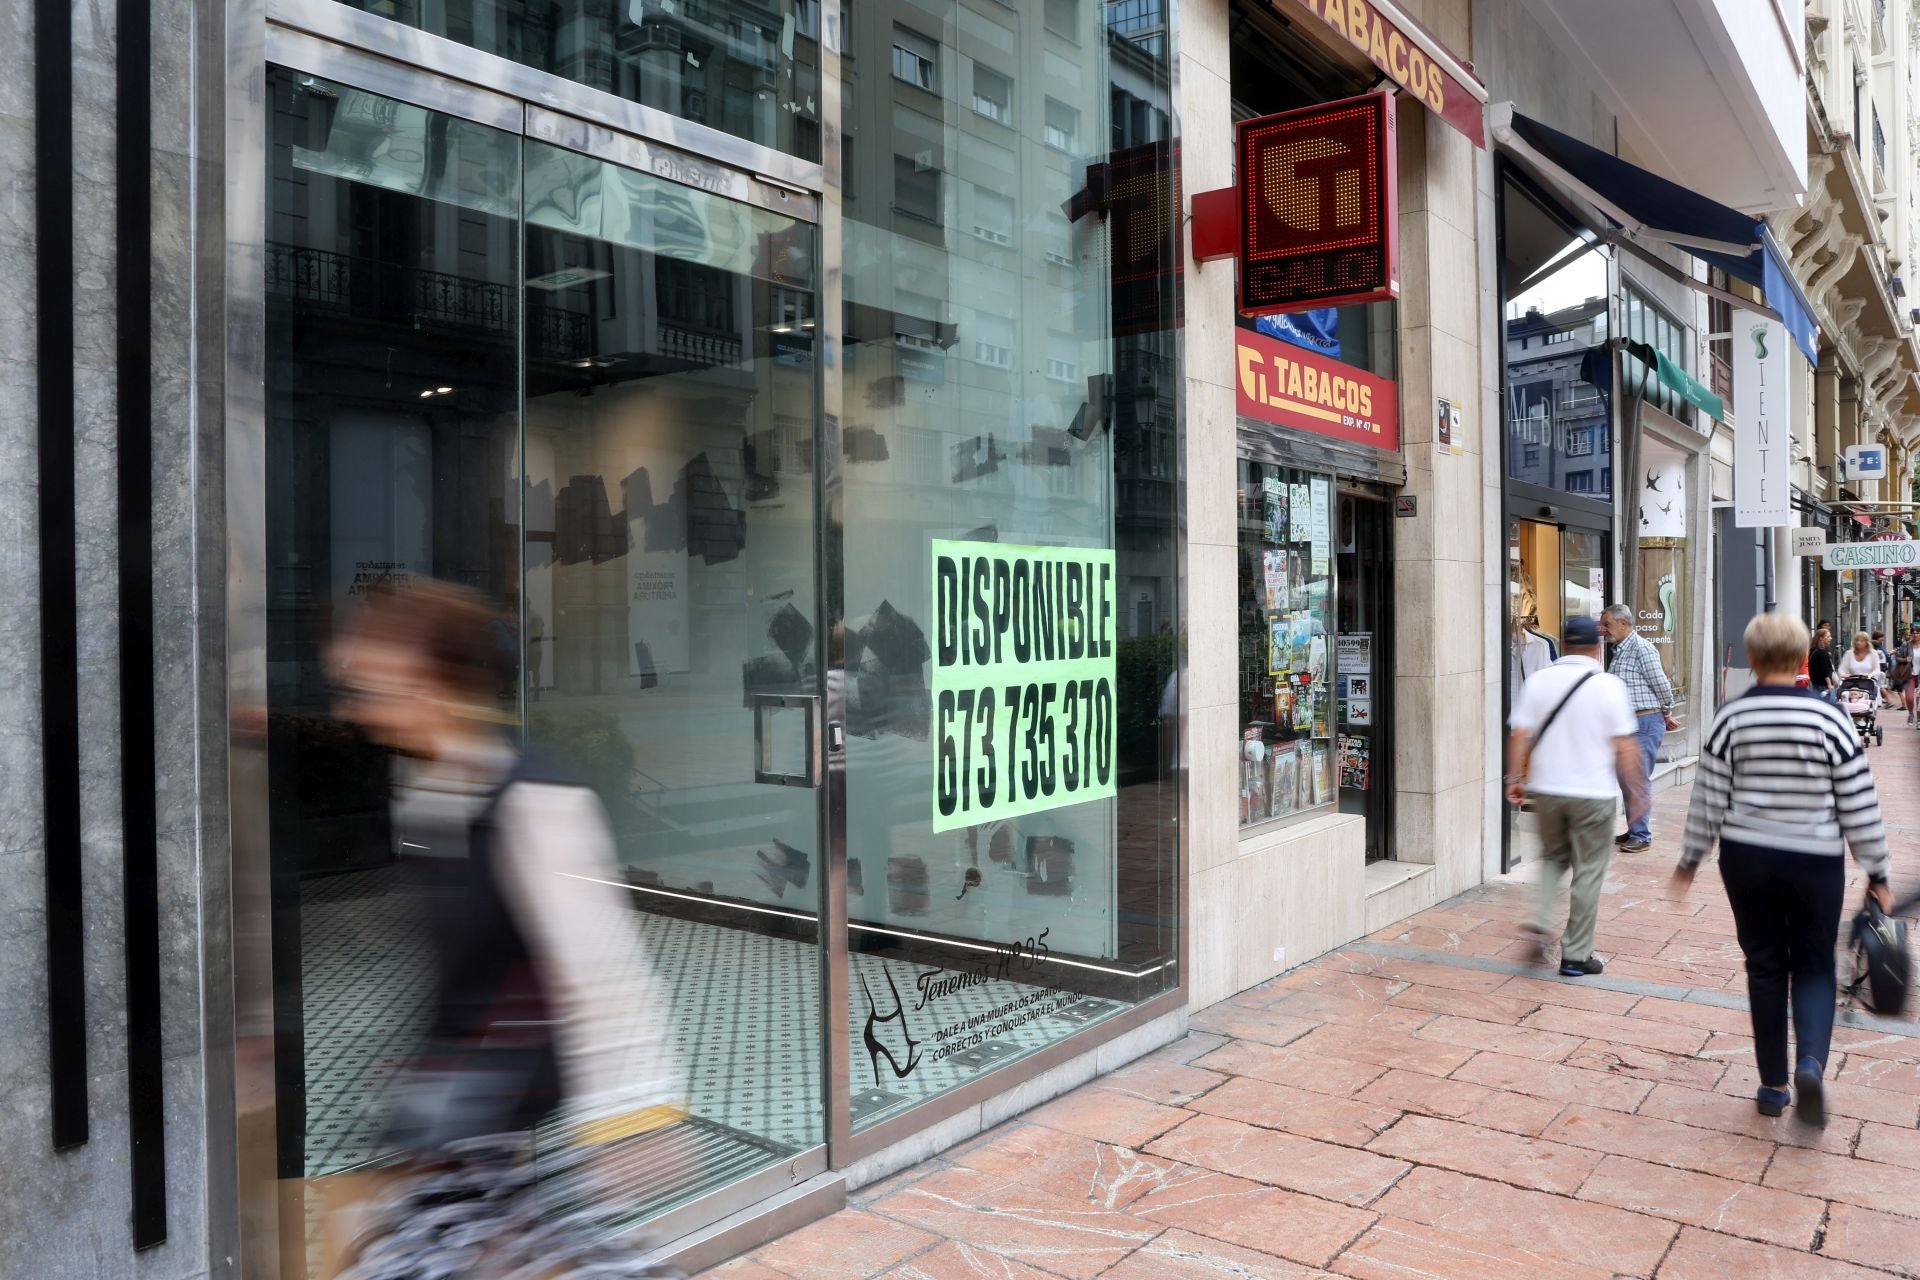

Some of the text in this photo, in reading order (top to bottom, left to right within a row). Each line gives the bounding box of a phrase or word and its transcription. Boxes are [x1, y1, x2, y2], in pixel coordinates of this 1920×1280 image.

[1274, 355, 1372, 418] TABACOS
[1343, 415, 1355, 428] EXP.
[1363, 421, 1371, 432] 47
[1541, 395, 1573, 457] Blue
[1830, 543, 1917, 566] CASINO
[937, 555, 1111, 667] DISPONIBLE
[1635, 624, 1658, 633] paso
[1638, 609, 1664, 620] Cada
[937, 677, 1112, 816] 673 735 370
[915, 964, 989, 1011] Tenemos
[960, 1021, 966, 1033] A
[967, 1013, 986, 1029] UNA
[986, 1002, 1014, 1022] MUJER
[1014, 996, 1029, 1011] LOS
[1029, 984, 1062, 1004] ZAPATOS
[932, 1031, 983, 1062] CORRECTOS
[984, 1029, 990, 1040] Y
[1046, 1002, 1055, 1014] EL
